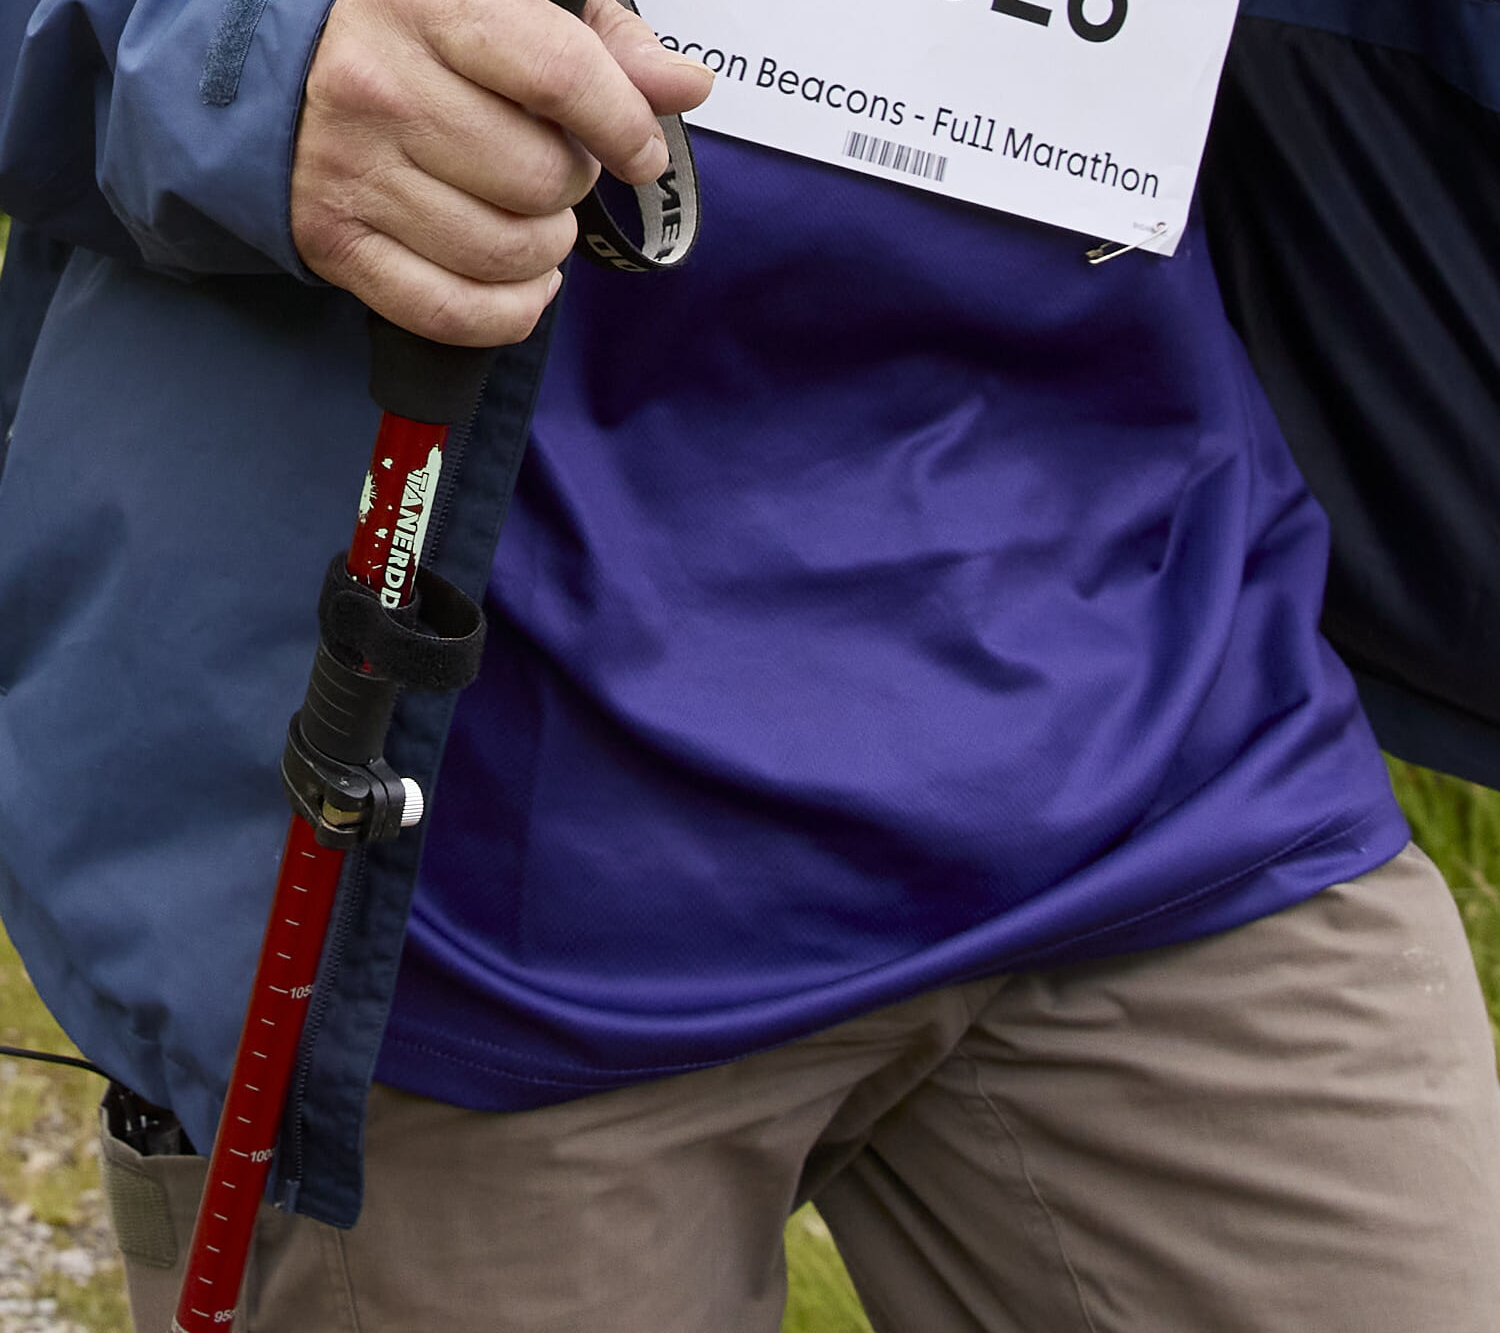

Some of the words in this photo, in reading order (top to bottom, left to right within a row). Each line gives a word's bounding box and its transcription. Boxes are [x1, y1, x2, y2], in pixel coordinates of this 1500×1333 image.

[756, 57, 906, 125] Beacons
[932, 107, 996, 152] Full
[1002, 127, 1159, 198] Marathon
[380, 470, 430, 609] TANERDD
